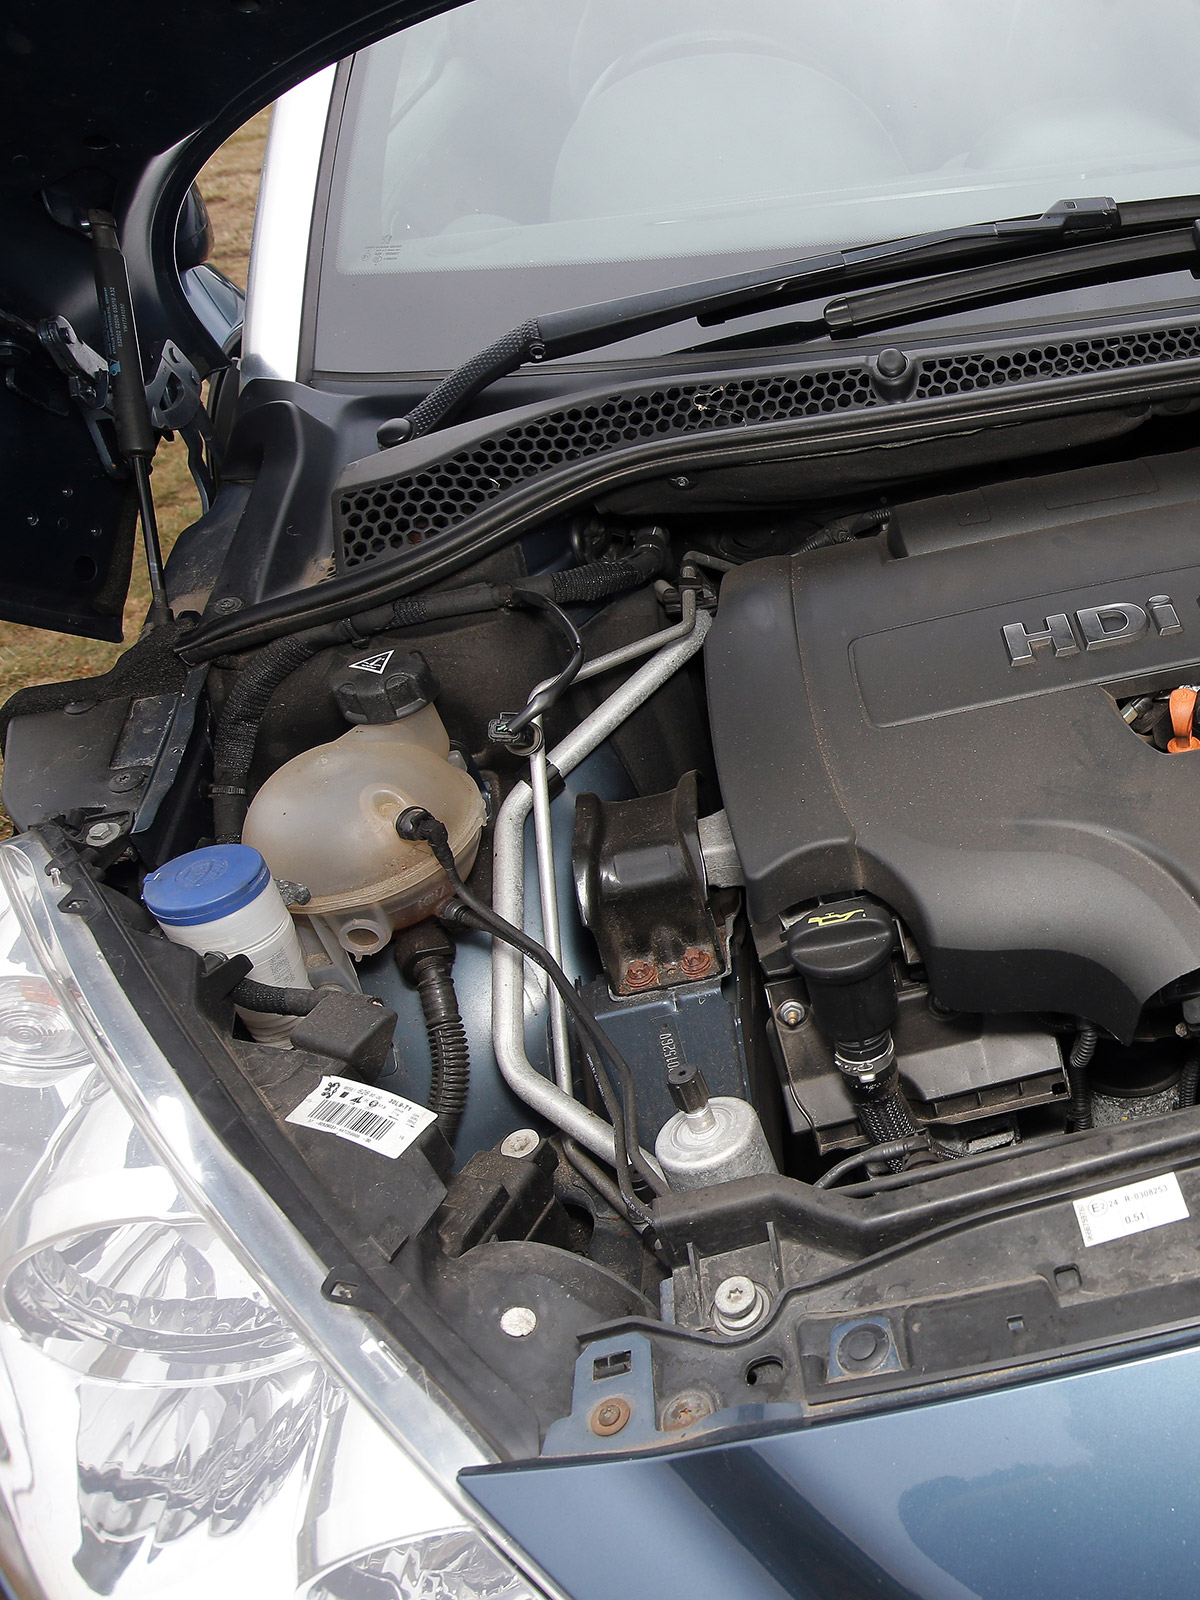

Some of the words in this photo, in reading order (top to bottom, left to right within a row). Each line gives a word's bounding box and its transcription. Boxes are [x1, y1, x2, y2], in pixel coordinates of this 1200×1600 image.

[1001, 594, 1184, 667] HDi
[658, 1033, 681, 1073] 015260
[1109, 1199, 1119, 1208] 24
[1124, 1211, 1145, 1225] 0.51
